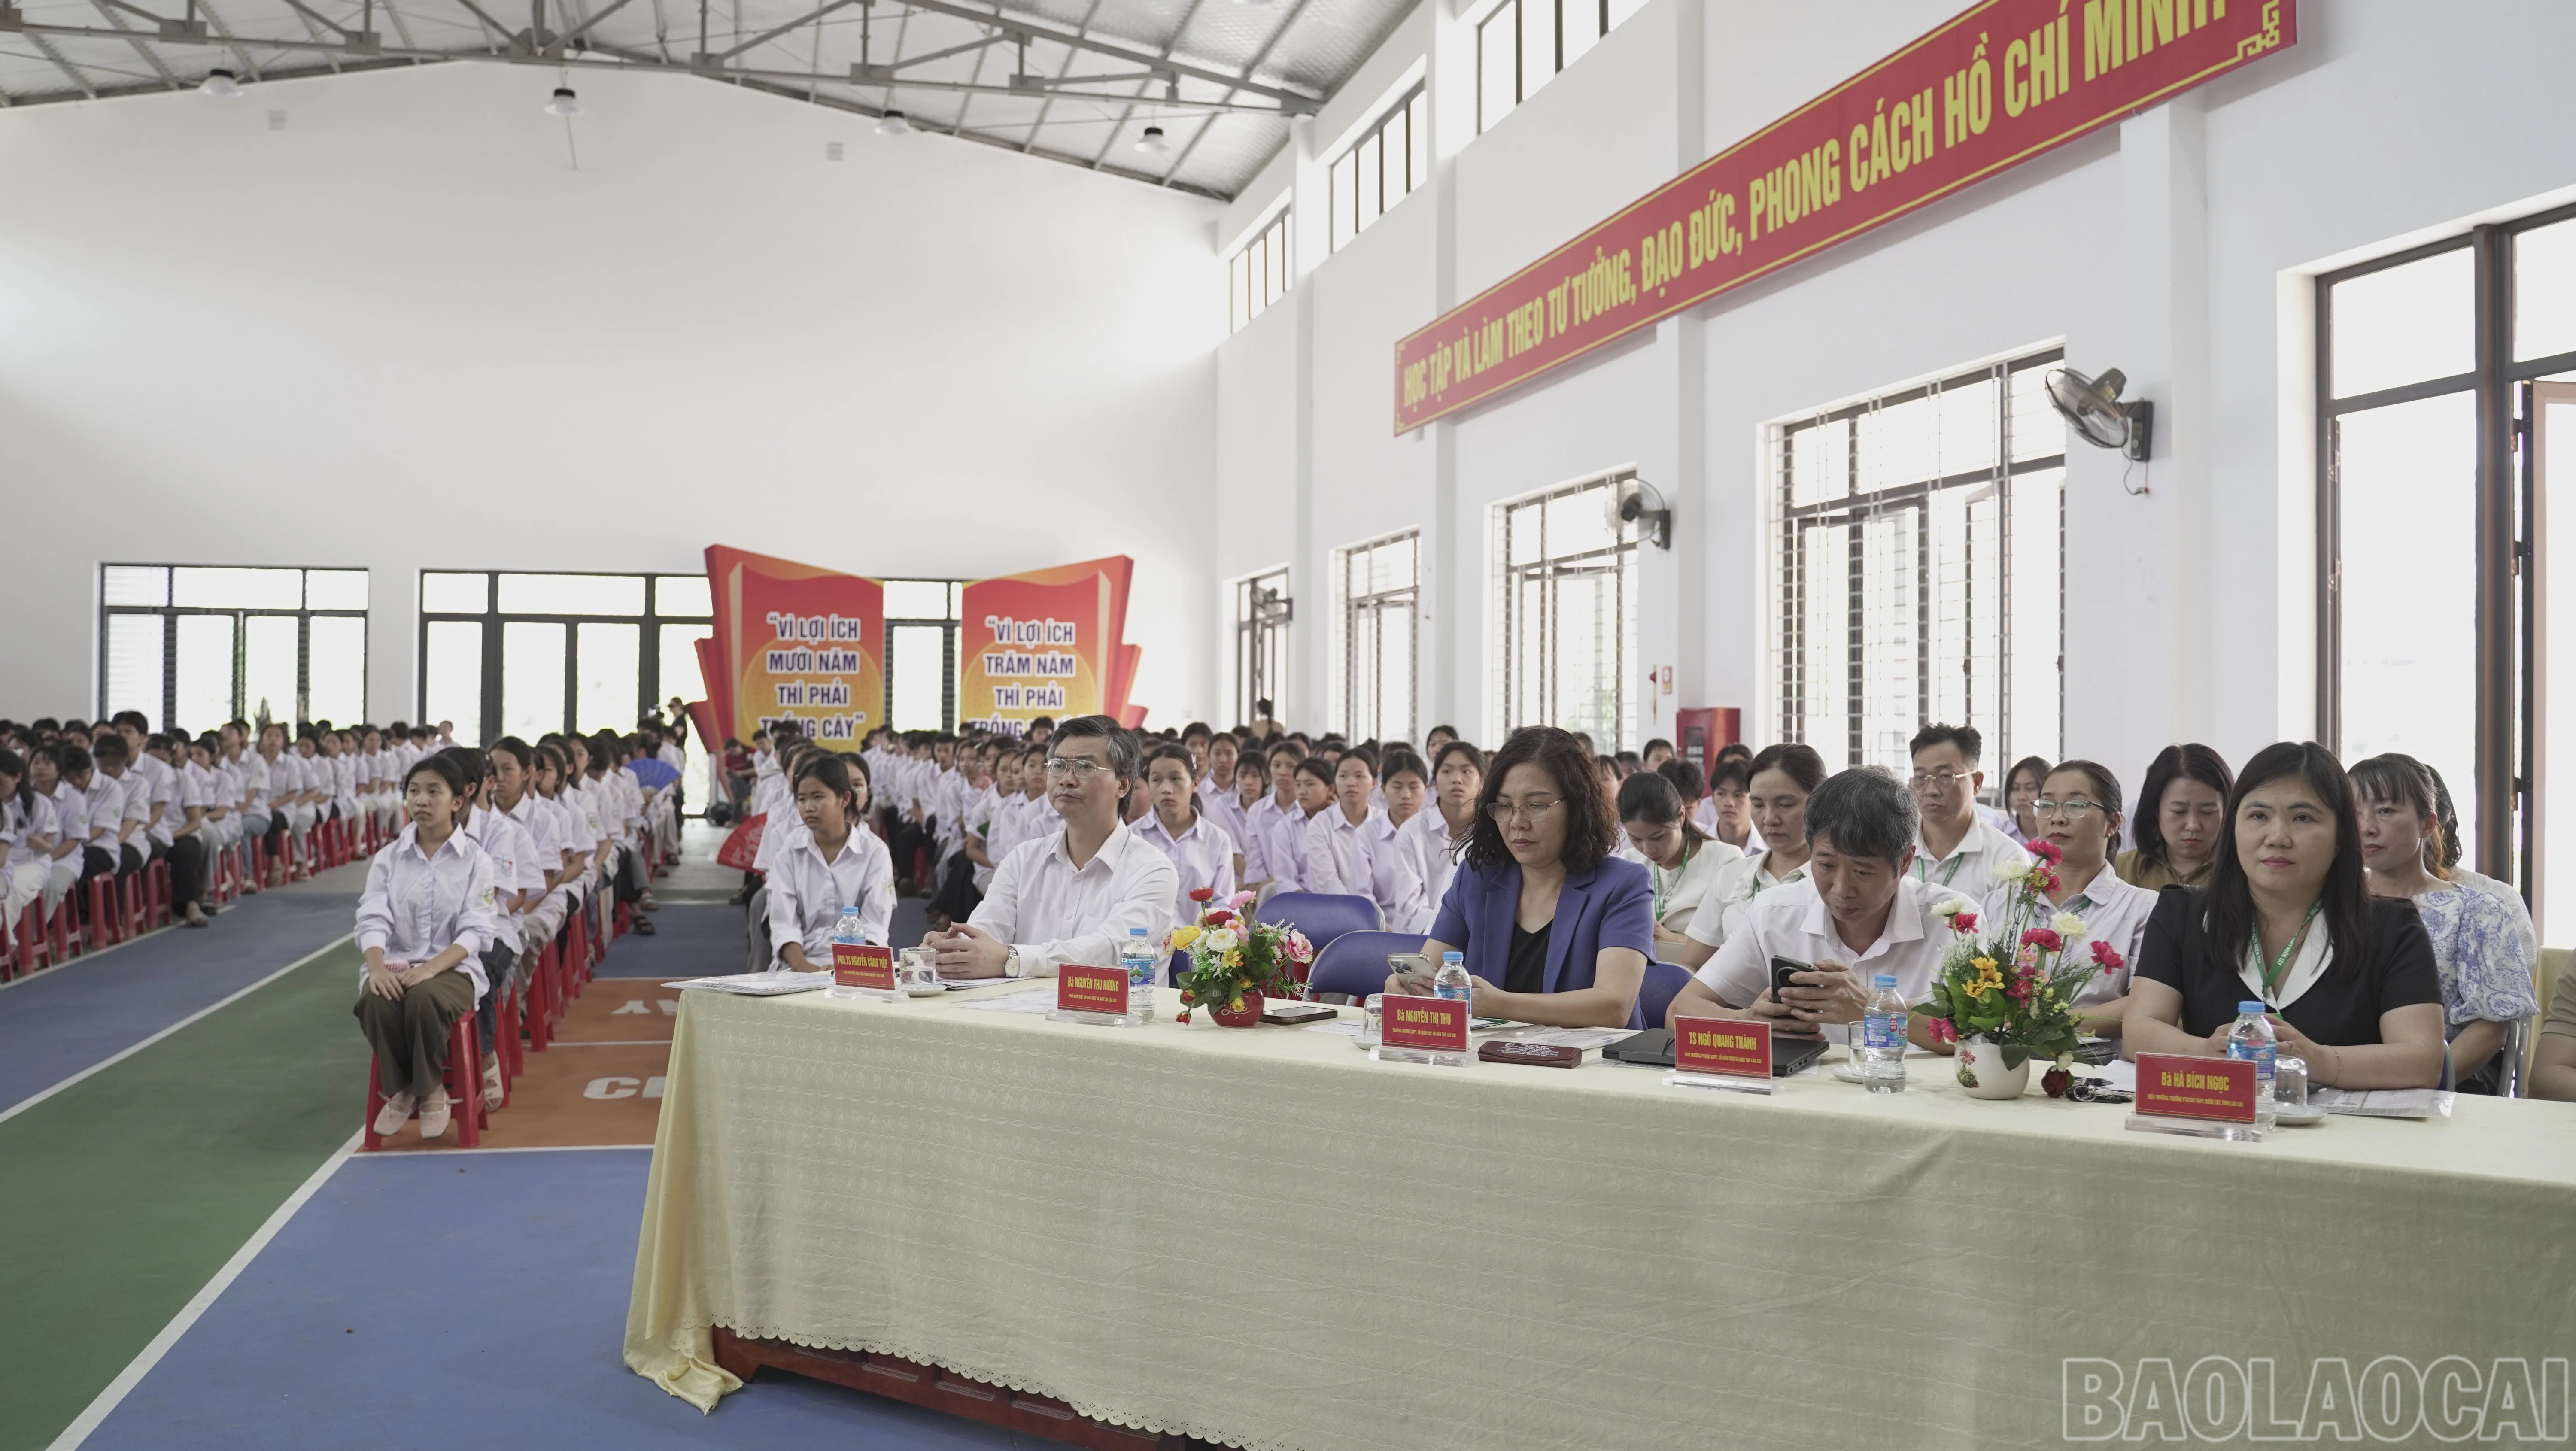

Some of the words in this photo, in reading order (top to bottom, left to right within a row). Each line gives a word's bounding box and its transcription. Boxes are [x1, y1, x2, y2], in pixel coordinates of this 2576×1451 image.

[1404, 358, 1427, 413] HỌC
[1429, 340, 1452, 402] TẬP
[1454, 326, 1472, 383] VÀ
[1473, 316, 1503, 375] LÀM
[1506, 296, 1544, 358] THEO
[1547, 276, 1570, 338] TƯ
[1571, 245, 1637, 326] TƯỞNG,
[1640, 220, 1684, 297] ĐẠO
[1688, 188, 1743, 270] ĐỨC,
[1748, 137, 1841, 242] PHONG
[1849, 97, 1934, 192] CÁCH
[1944, 31, 1992, 149] HỒ
[2003, 0, 2070, 118] CHÍ
[799, 617, 824, 644] LỢI
[830, 615, 857, 639] ÍCH
[1017, 622, 1041, 646] LỢI
[1046, 619, 1072, 642] ÍCH
[769, 647, 812, 671] MƯỜI
[818, 648, 857, 671] NĂM
[986, 651, 1030, 674] TRĂM
[1036, 652, 1073, 674] NĂM
[778, 680, 802, 704] THÌ
[809, 679, 848, 705] PHẢI
[996, 683, 1019, 706] THÌ
[1025, 682, 1063, 707] PHẢI
[837, 954, 851, 965] PGS.TS
[851, 953, 868, 967] NGUYỄN
[867, 955, 879, 968] CÔNG
[879, 956, 888, 970] TIỆP
[1067, 976, 1074, 987] Bà
[1075, 974, 1093, 989] NGUYỄN
[1094, 978, 1103, 990] THU
[1103, 979, 1119, 992] HƯƠNG
[1397, 1009, 1405, 1021] Bà
[1406, 1007, 1428, 1023] NGUYỄN
[1429, 1011, 1439, 1027] THỊ
[1440, 1012, 1452, 1026] THU
[1689, 1031, 1697, 1044] TS
[1698, 1030, 1711, 1046] NGÔ
[1713, 1034, 1734, 1048] QUANG
[1735, 1033, 1756, 1050] THÀNH
[2161, 1072, 2172, 1087] Bà
[2173, 1070, 2185, 1087] HÀ
[2186, 1071, 2205, 1089] BÍCH
[2206, 1075, 2230, 1094] NGỌC
